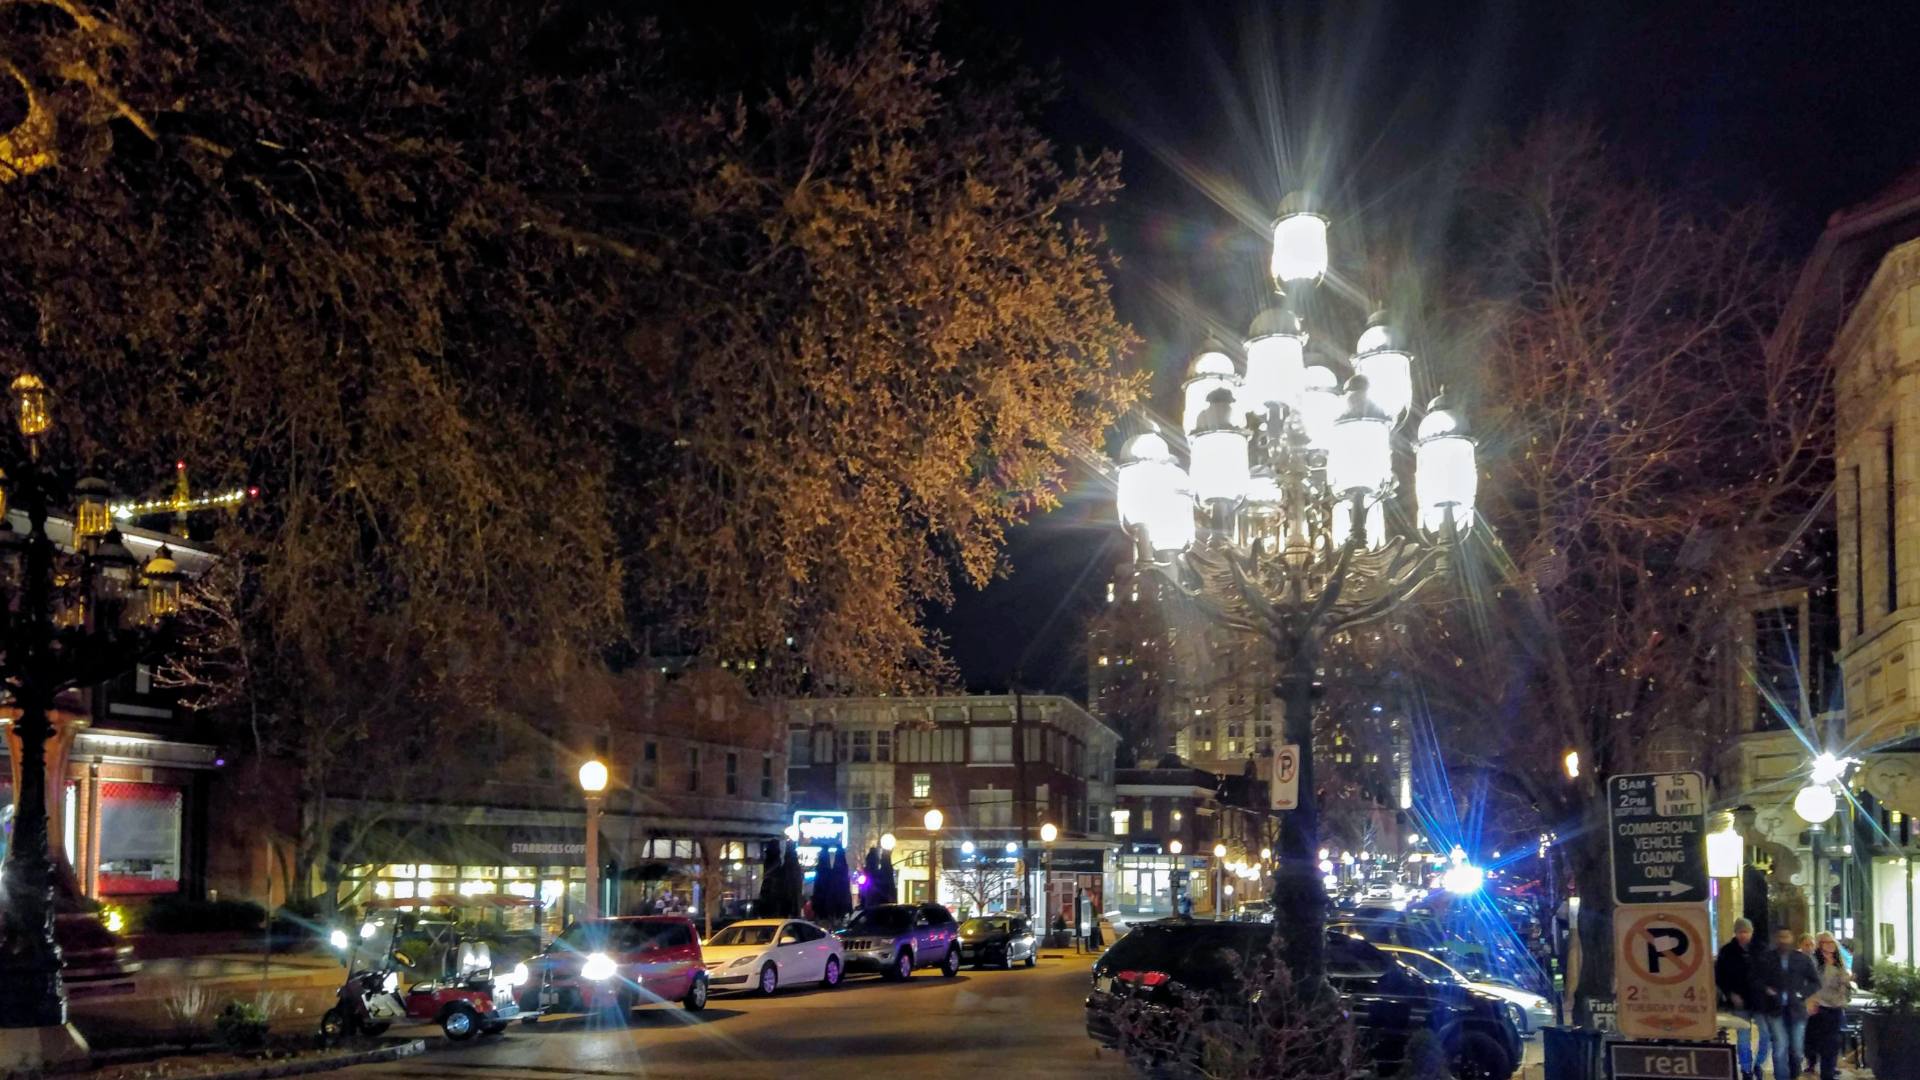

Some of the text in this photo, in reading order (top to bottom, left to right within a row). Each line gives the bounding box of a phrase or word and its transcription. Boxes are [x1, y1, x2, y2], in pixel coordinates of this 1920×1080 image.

[1618, 779, 1646, 790] 8AM
[1672, 774, 1685, 786] 15
[1620, 795, 1647, 807] 2PM
[1663, 803, 1696, 816] LIMIT
[1618, 821, 1697, 836] COMMERCIAL
[511, 843, 586, 854] STARBUCKS COFF
[1634, 836, 1683, 849] VEHICLE
[1633, 851, 1685, 864] LOADING
[1645, 866, 1674, 878] ONLY
[1647, 928, 1689, 973] P
[1627, 986, 1639, 1000] 2
[1684, 986, 1697, 1001] 4
[1626, 1002, 1708, 1013] TUESDAY ONLY
[1593, 1013, 1617, 1030] FR
[1645, 1051, 1698, 1074] real
